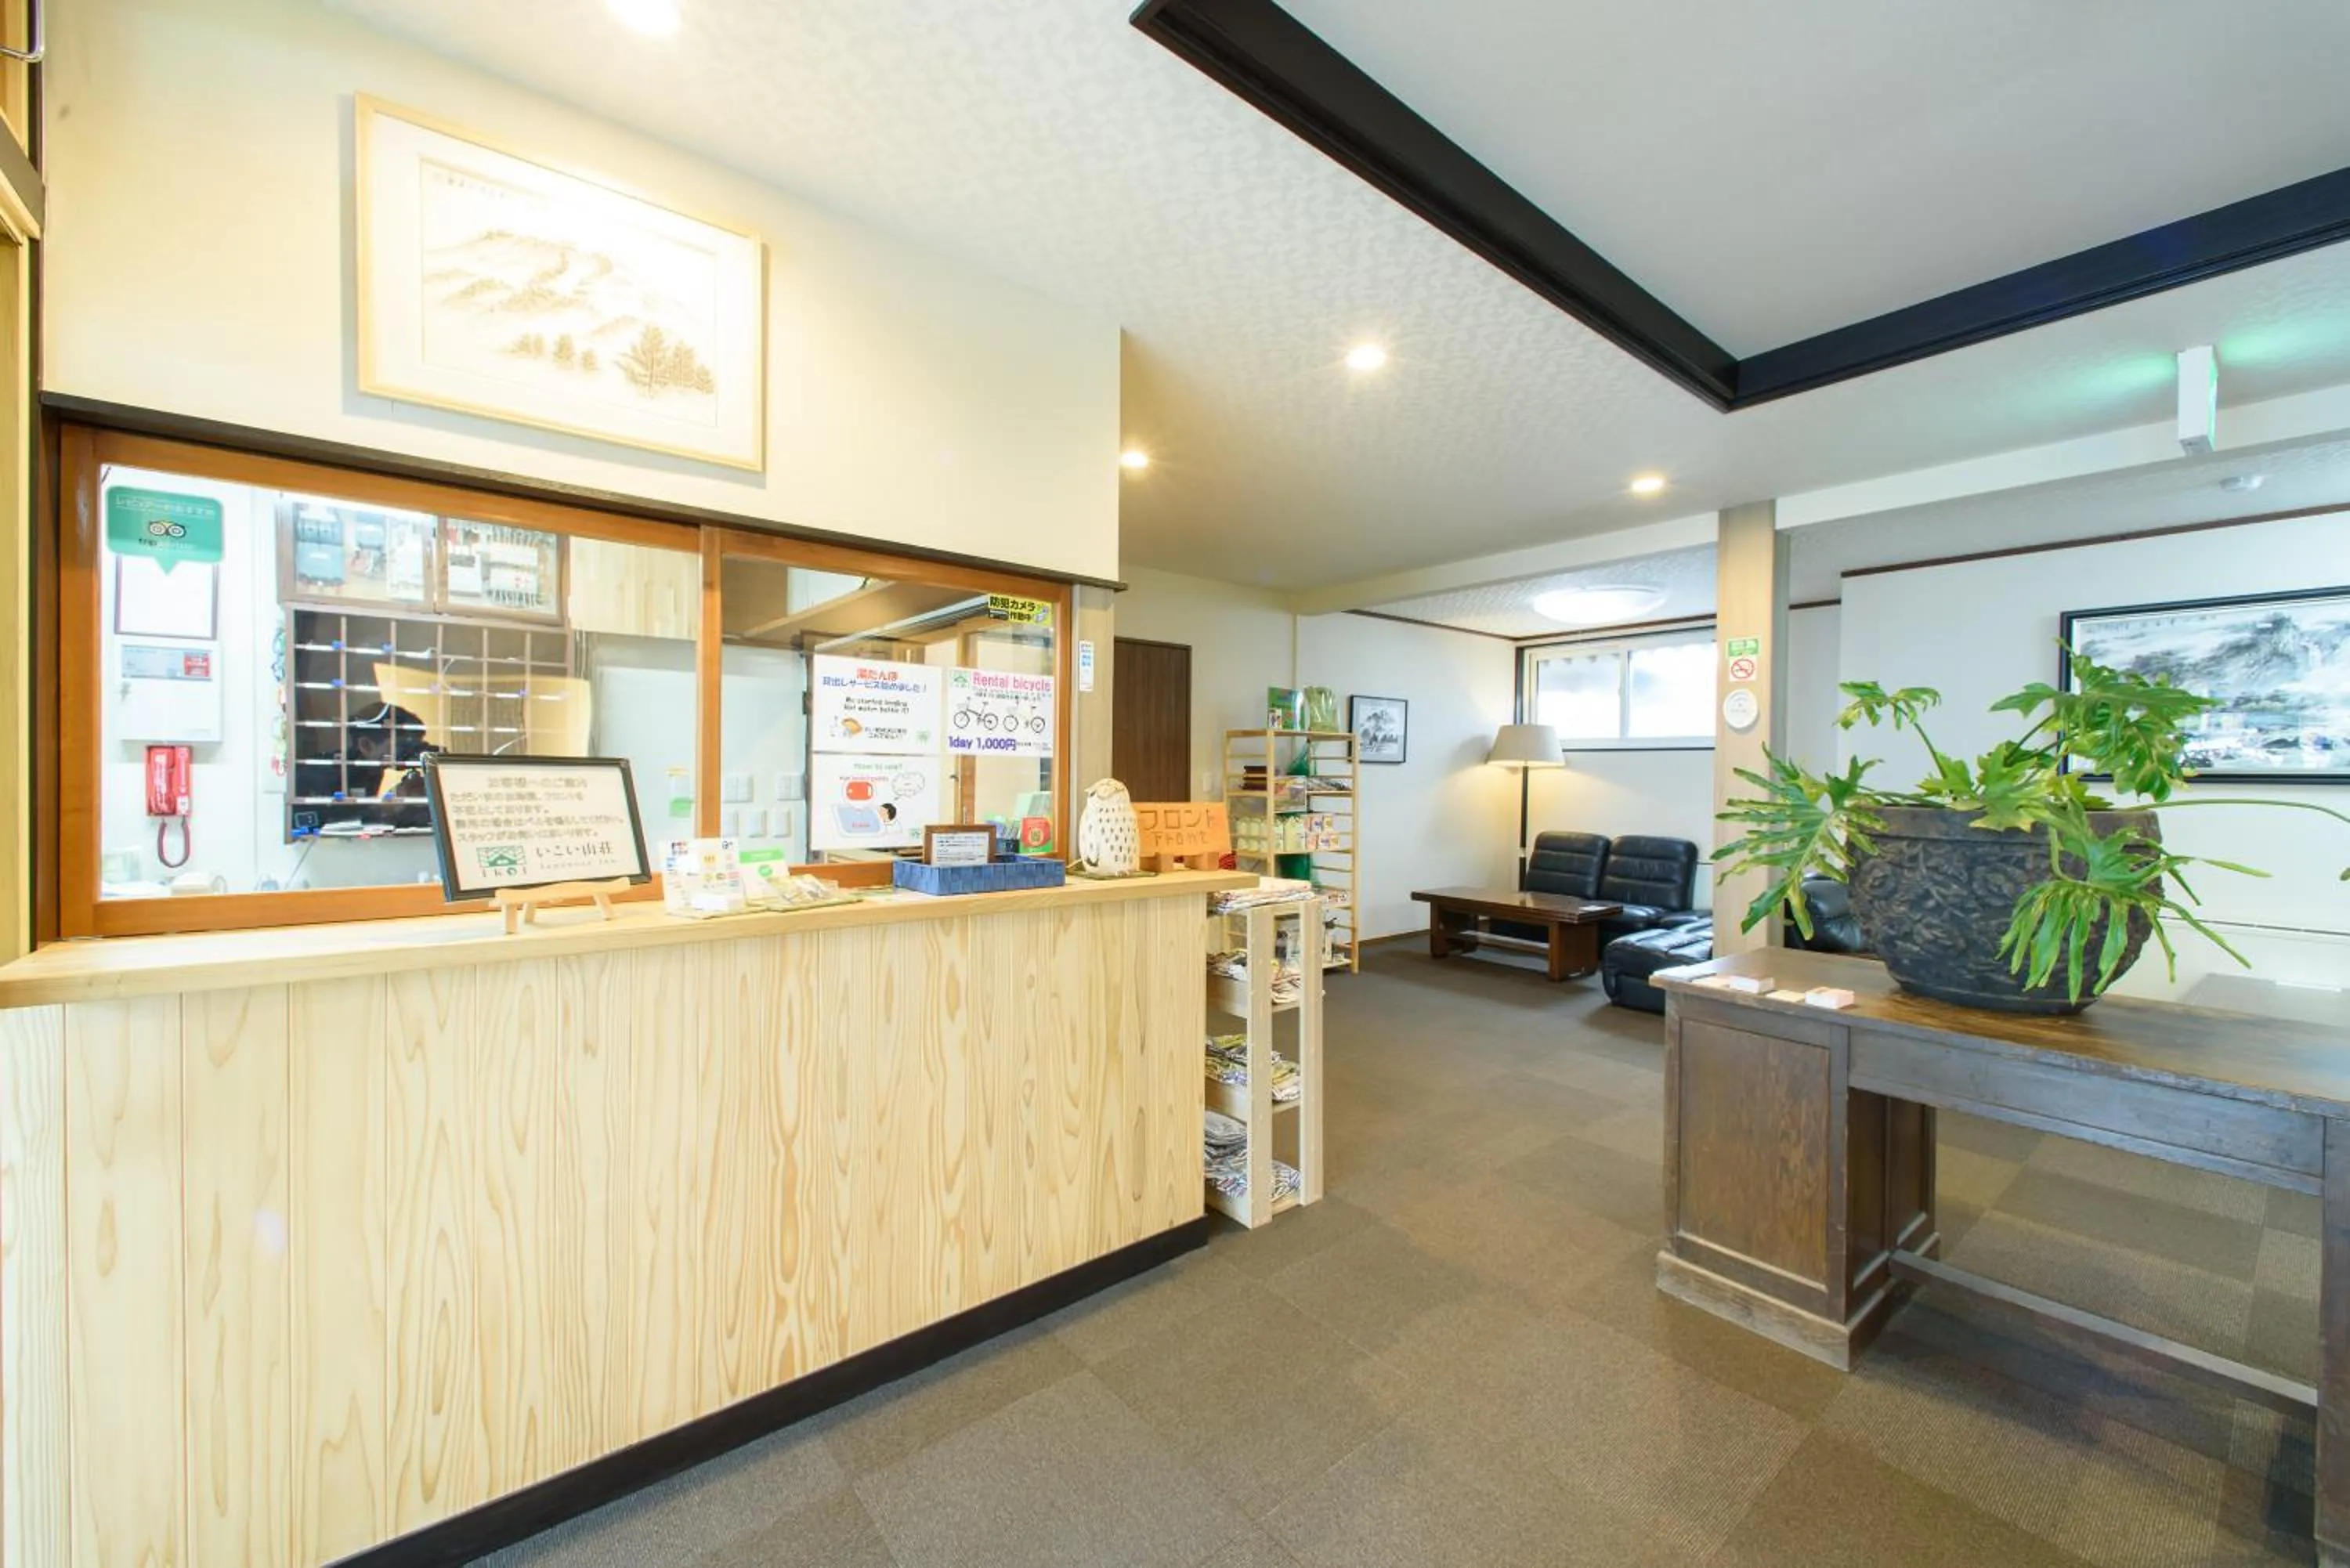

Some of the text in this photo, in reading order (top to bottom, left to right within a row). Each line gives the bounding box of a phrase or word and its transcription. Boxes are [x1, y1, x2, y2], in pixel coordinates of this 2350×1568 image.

[989, 595, 1036, 612] 防犯カメラ
[1010, 612, 1032, 621] 作動中
[972, 671, 1050, 692] Rental bicycle
[948, 736, 973, 750] 1day
[976, 737, 1017, 751] 1,000円
[1139, 807, 1216, 831] フロント
